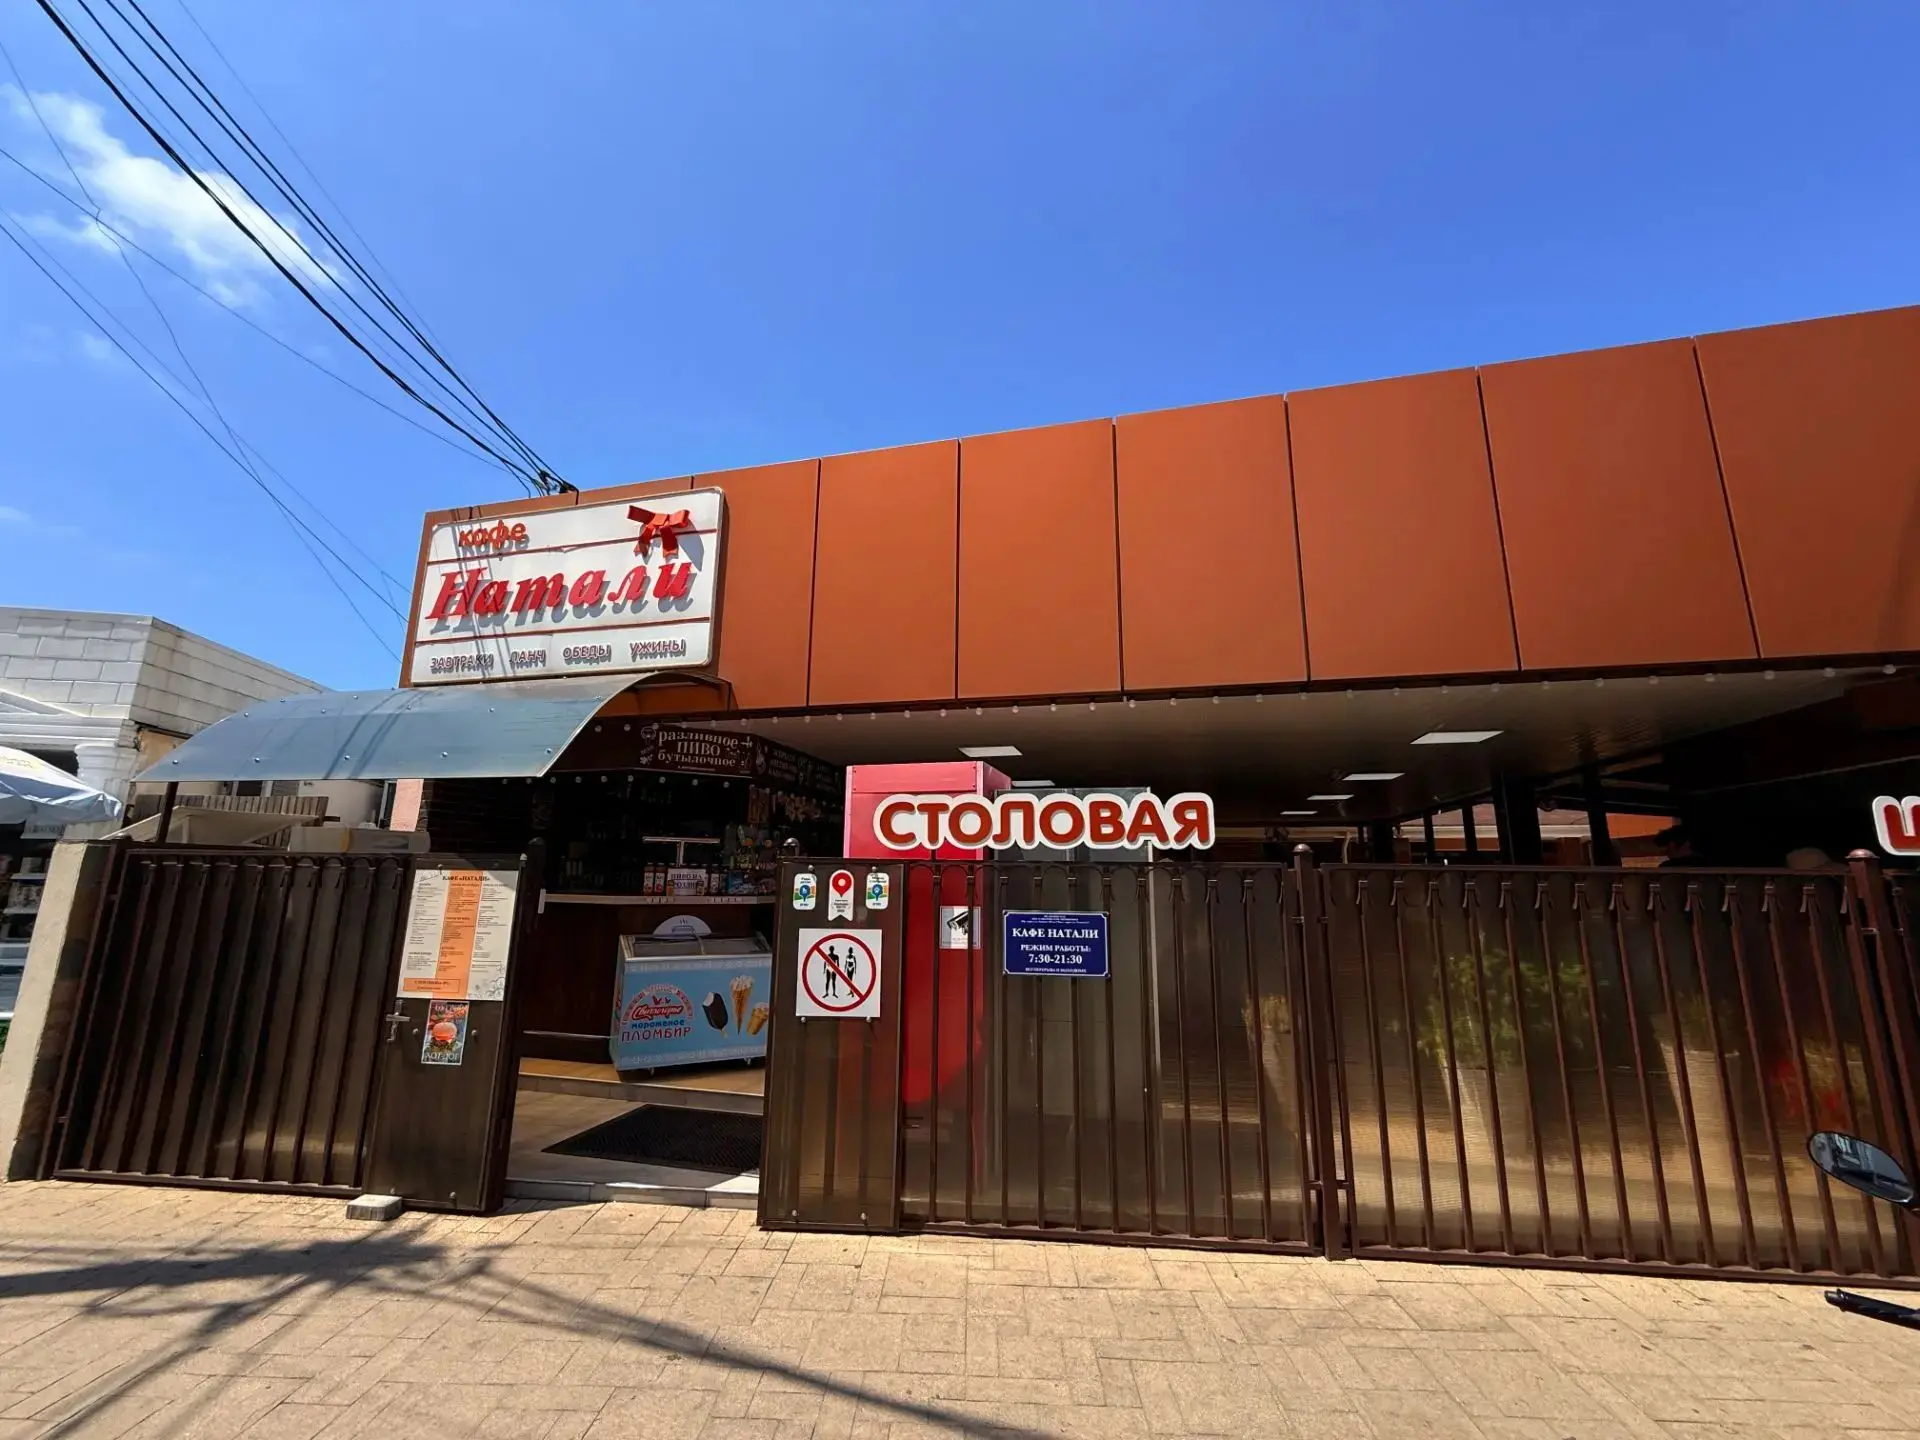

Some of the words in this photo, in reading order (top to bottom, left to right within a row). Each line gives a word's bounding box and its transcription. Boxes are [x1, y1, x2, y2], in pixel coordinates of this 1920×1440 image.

[459, 521, 526, 548] кафе
[425, 562, 692, 619] Натали
[430, 653, 494, 671] ЗАВТРАКИ
[510, 650, 546, 665] ЛАНЧ
[563, 645, 611, 661] ОБЕДЫ
[630, 639, 686, 655] УЖИНЫ
[658, 730, 739, 748] разливное
[658, 749, 736, 766] бутылочное
[677, 741, 720, 757] ПИВО
[876, 796, 1212, 848] СТОЛОВАЯ
[1012, 928, 1045, 938] КАФЕ
[1048, 928, 1099, 938] НАТАЛИ
[1020, 944, 1053, 952] РЕЖИМ
[1055, 944, 1091, 952] РАБОТЫ:
[1028, 954, 1083, 964] 7:30-21:30
[621, 1026, 691, 1042] ПЛОМБИР
